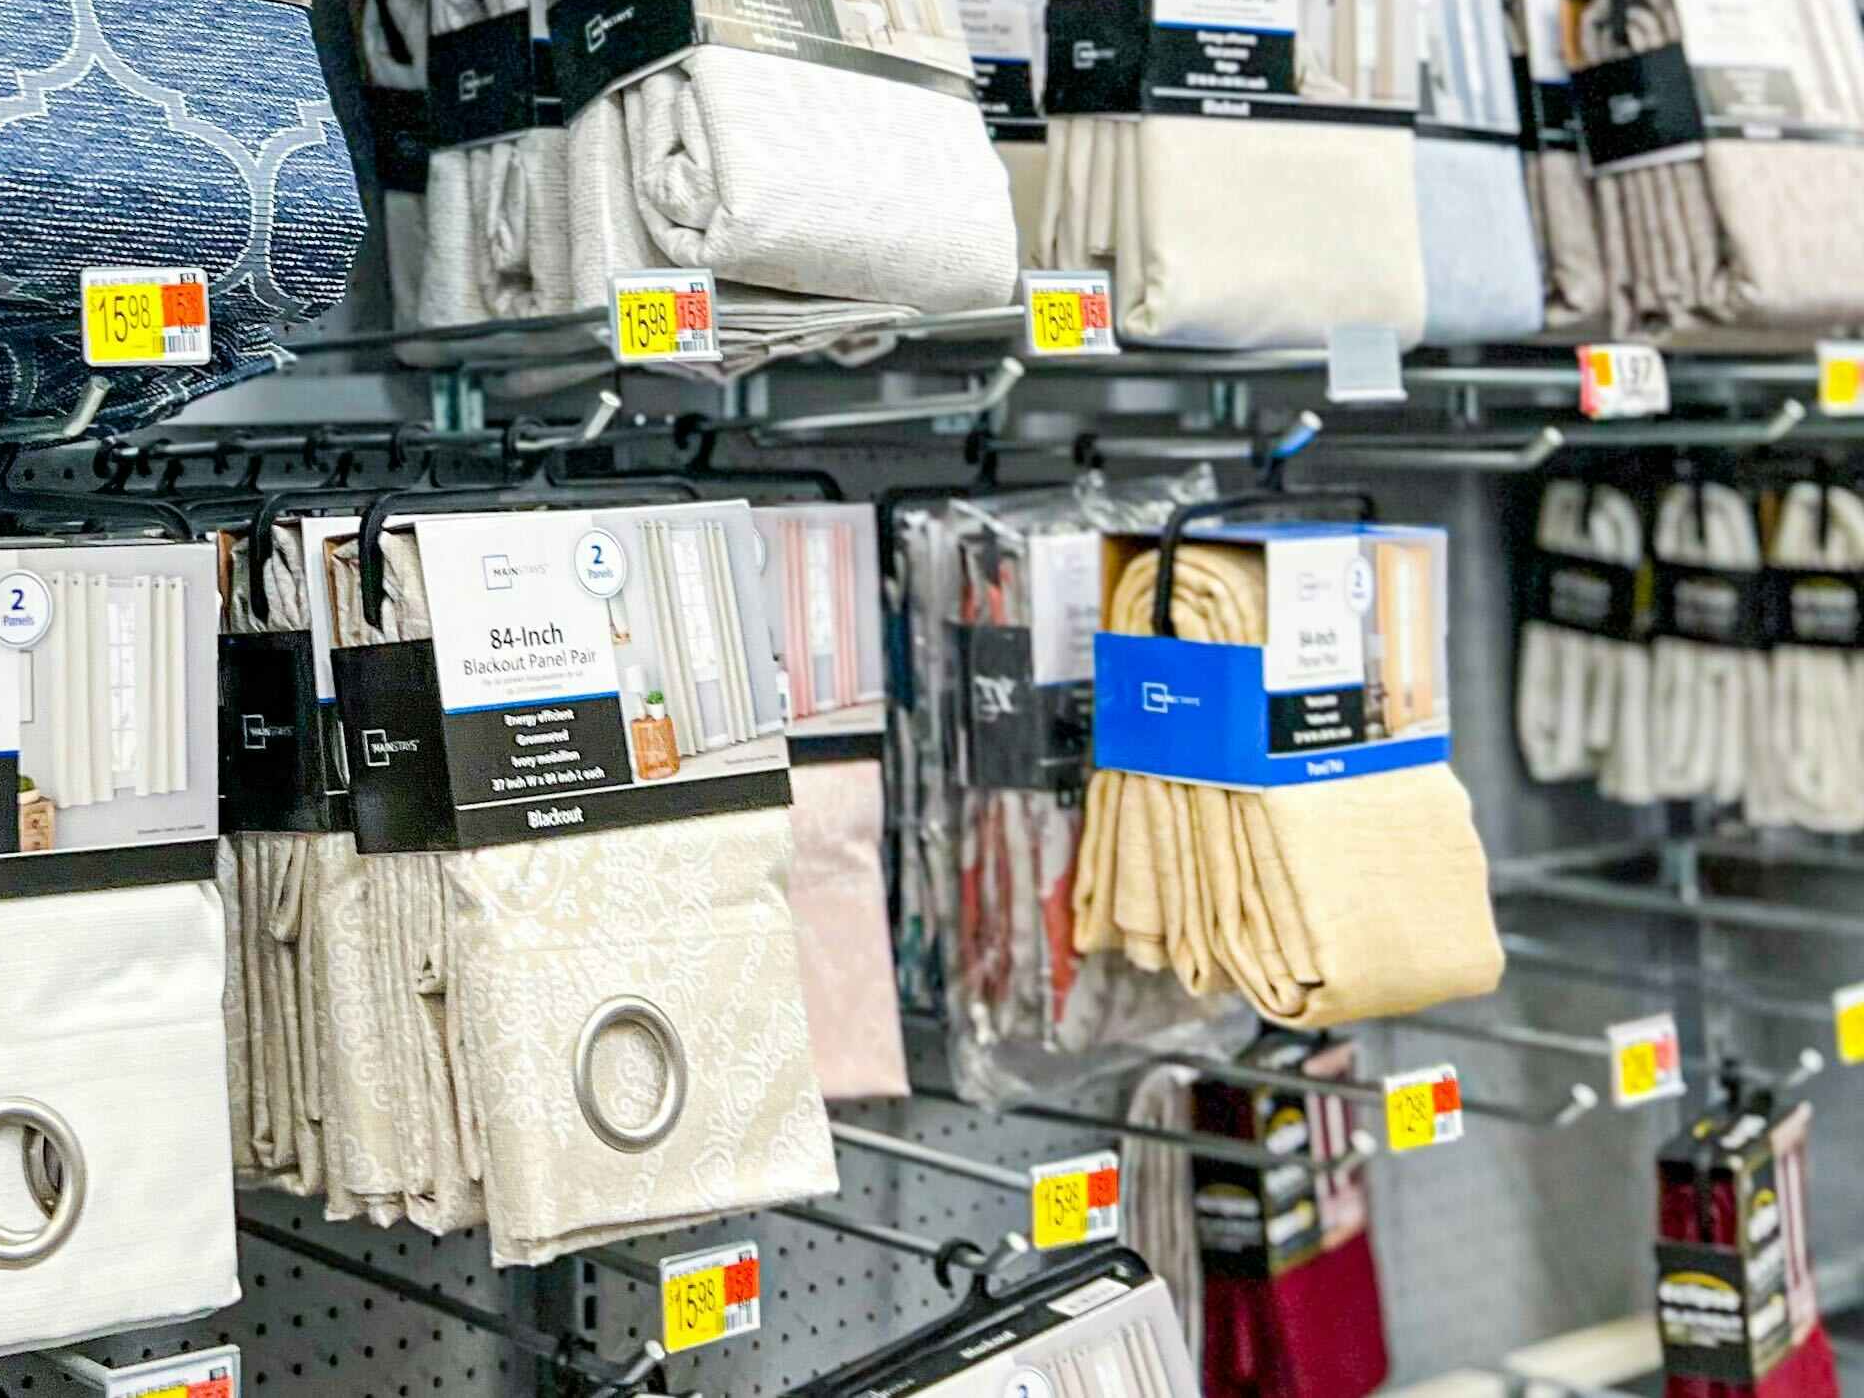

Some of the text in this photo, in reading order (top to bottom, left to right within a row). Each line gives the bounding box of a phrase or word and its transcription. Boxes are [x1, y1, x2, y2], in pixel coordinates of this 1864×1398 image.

[591, 545, 604, 564] 2
[11, 589, 25, 611] 2
[3, 615, 35, 627] Panels
[490, 621, 563, 650] 84-Inch
[463, 648, 596, 676] Blackout Panel Pair
[371, 739, 420, 755] MAINSTAYS
[527, 805, 584, 829] Blackout
